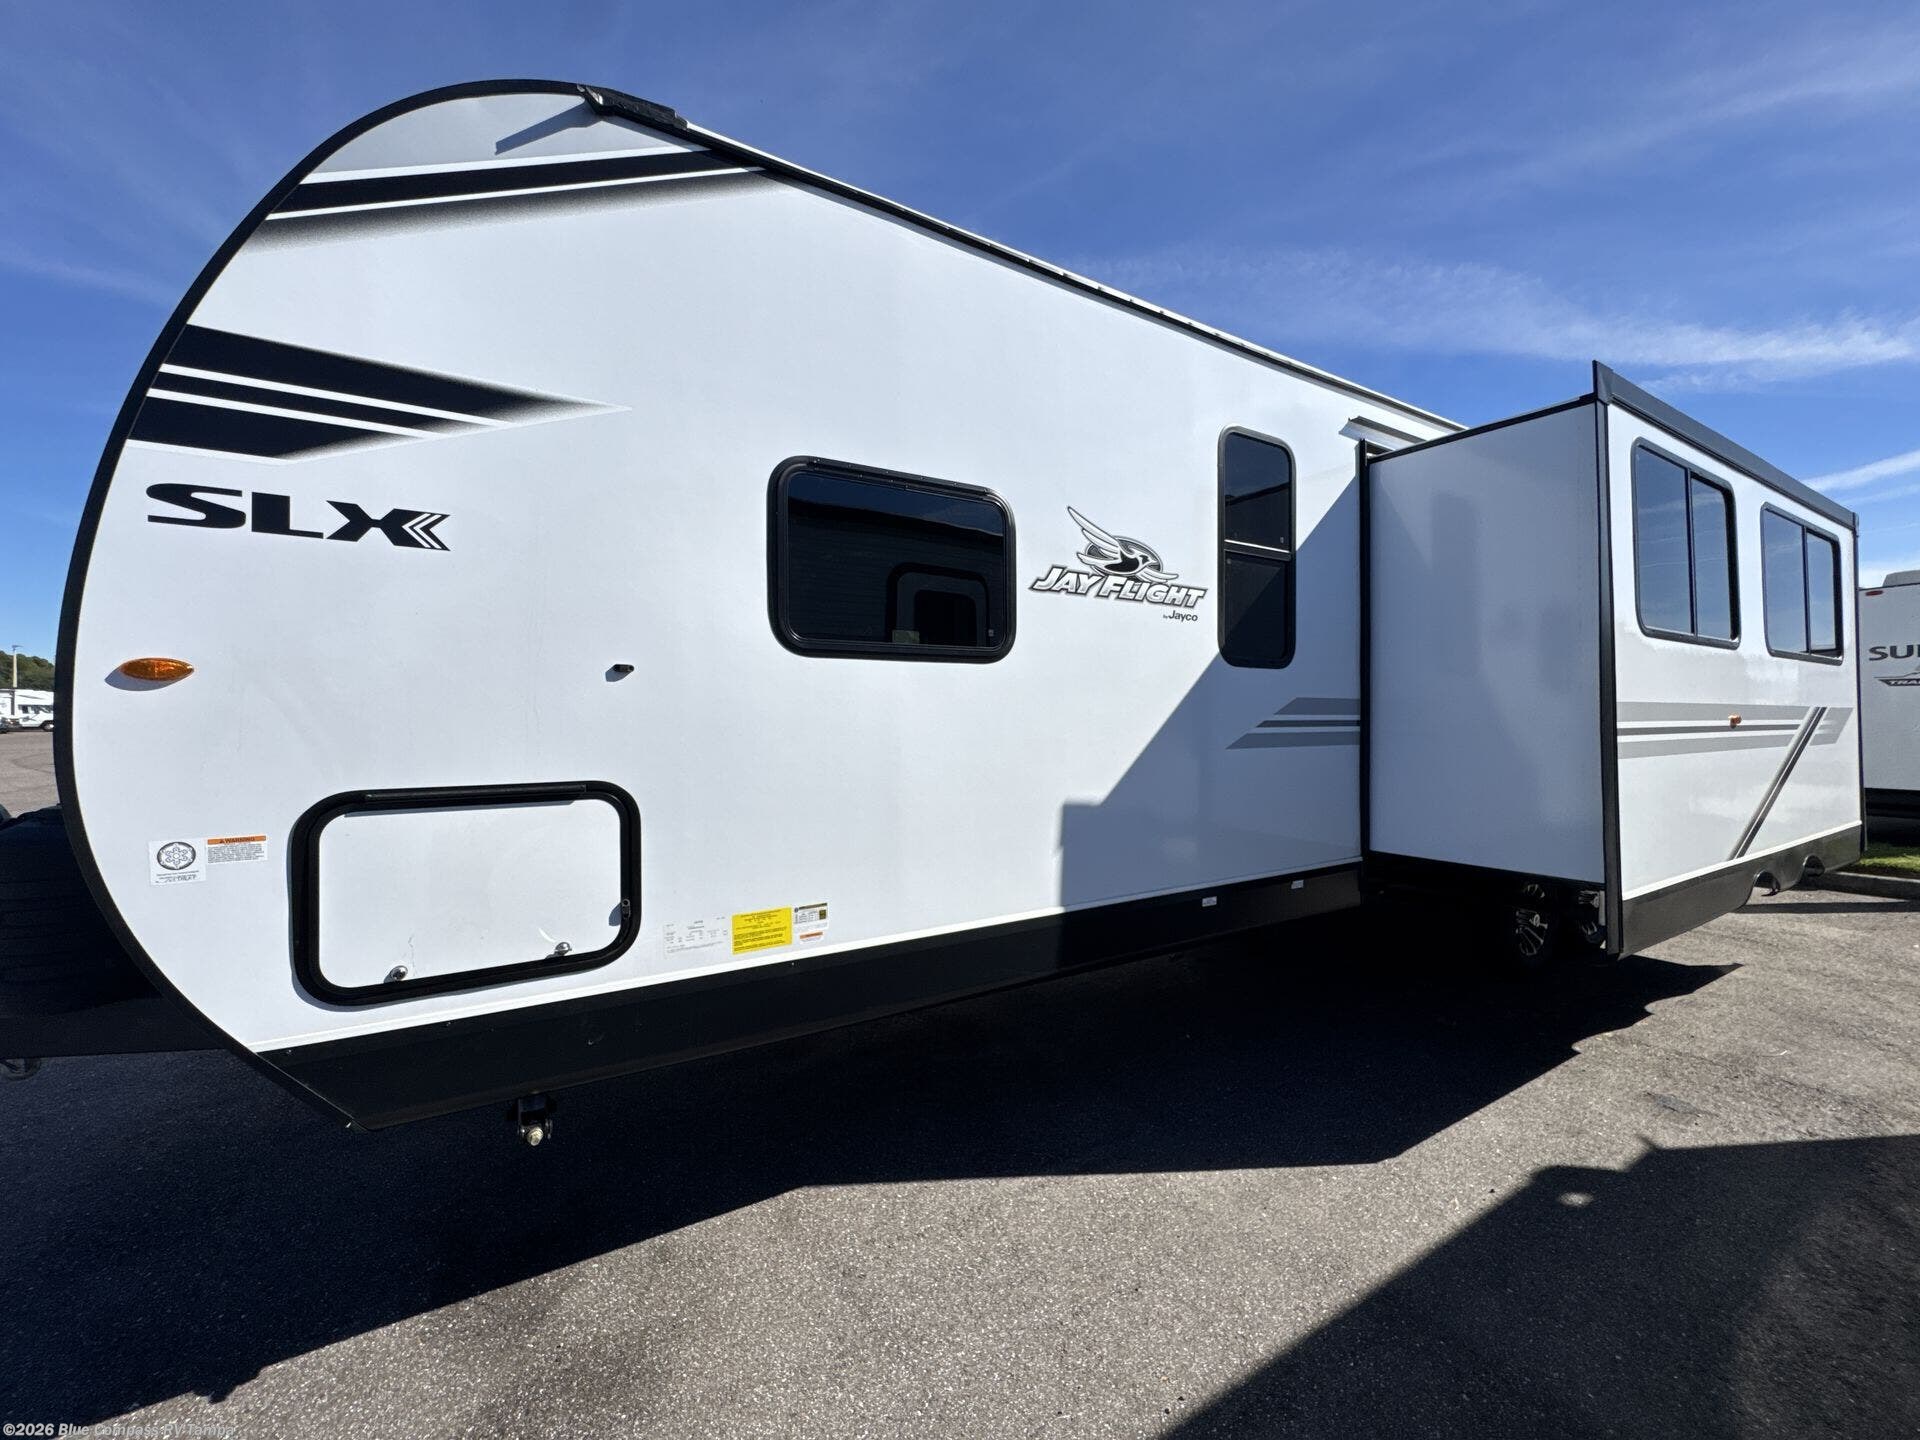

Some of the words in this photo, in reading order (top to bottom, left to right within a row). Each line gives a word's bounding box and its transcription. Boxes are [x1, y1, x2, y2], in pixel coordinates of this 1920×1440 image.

[146, 482, 450, 551] SLX
[1029, 565, 1101, 596] JAY
[1098, 574, 1208, 608] FLIGHT
[1168, 610, 1198, 623] Jayco
[1868, 644, 1920, 661] SU
